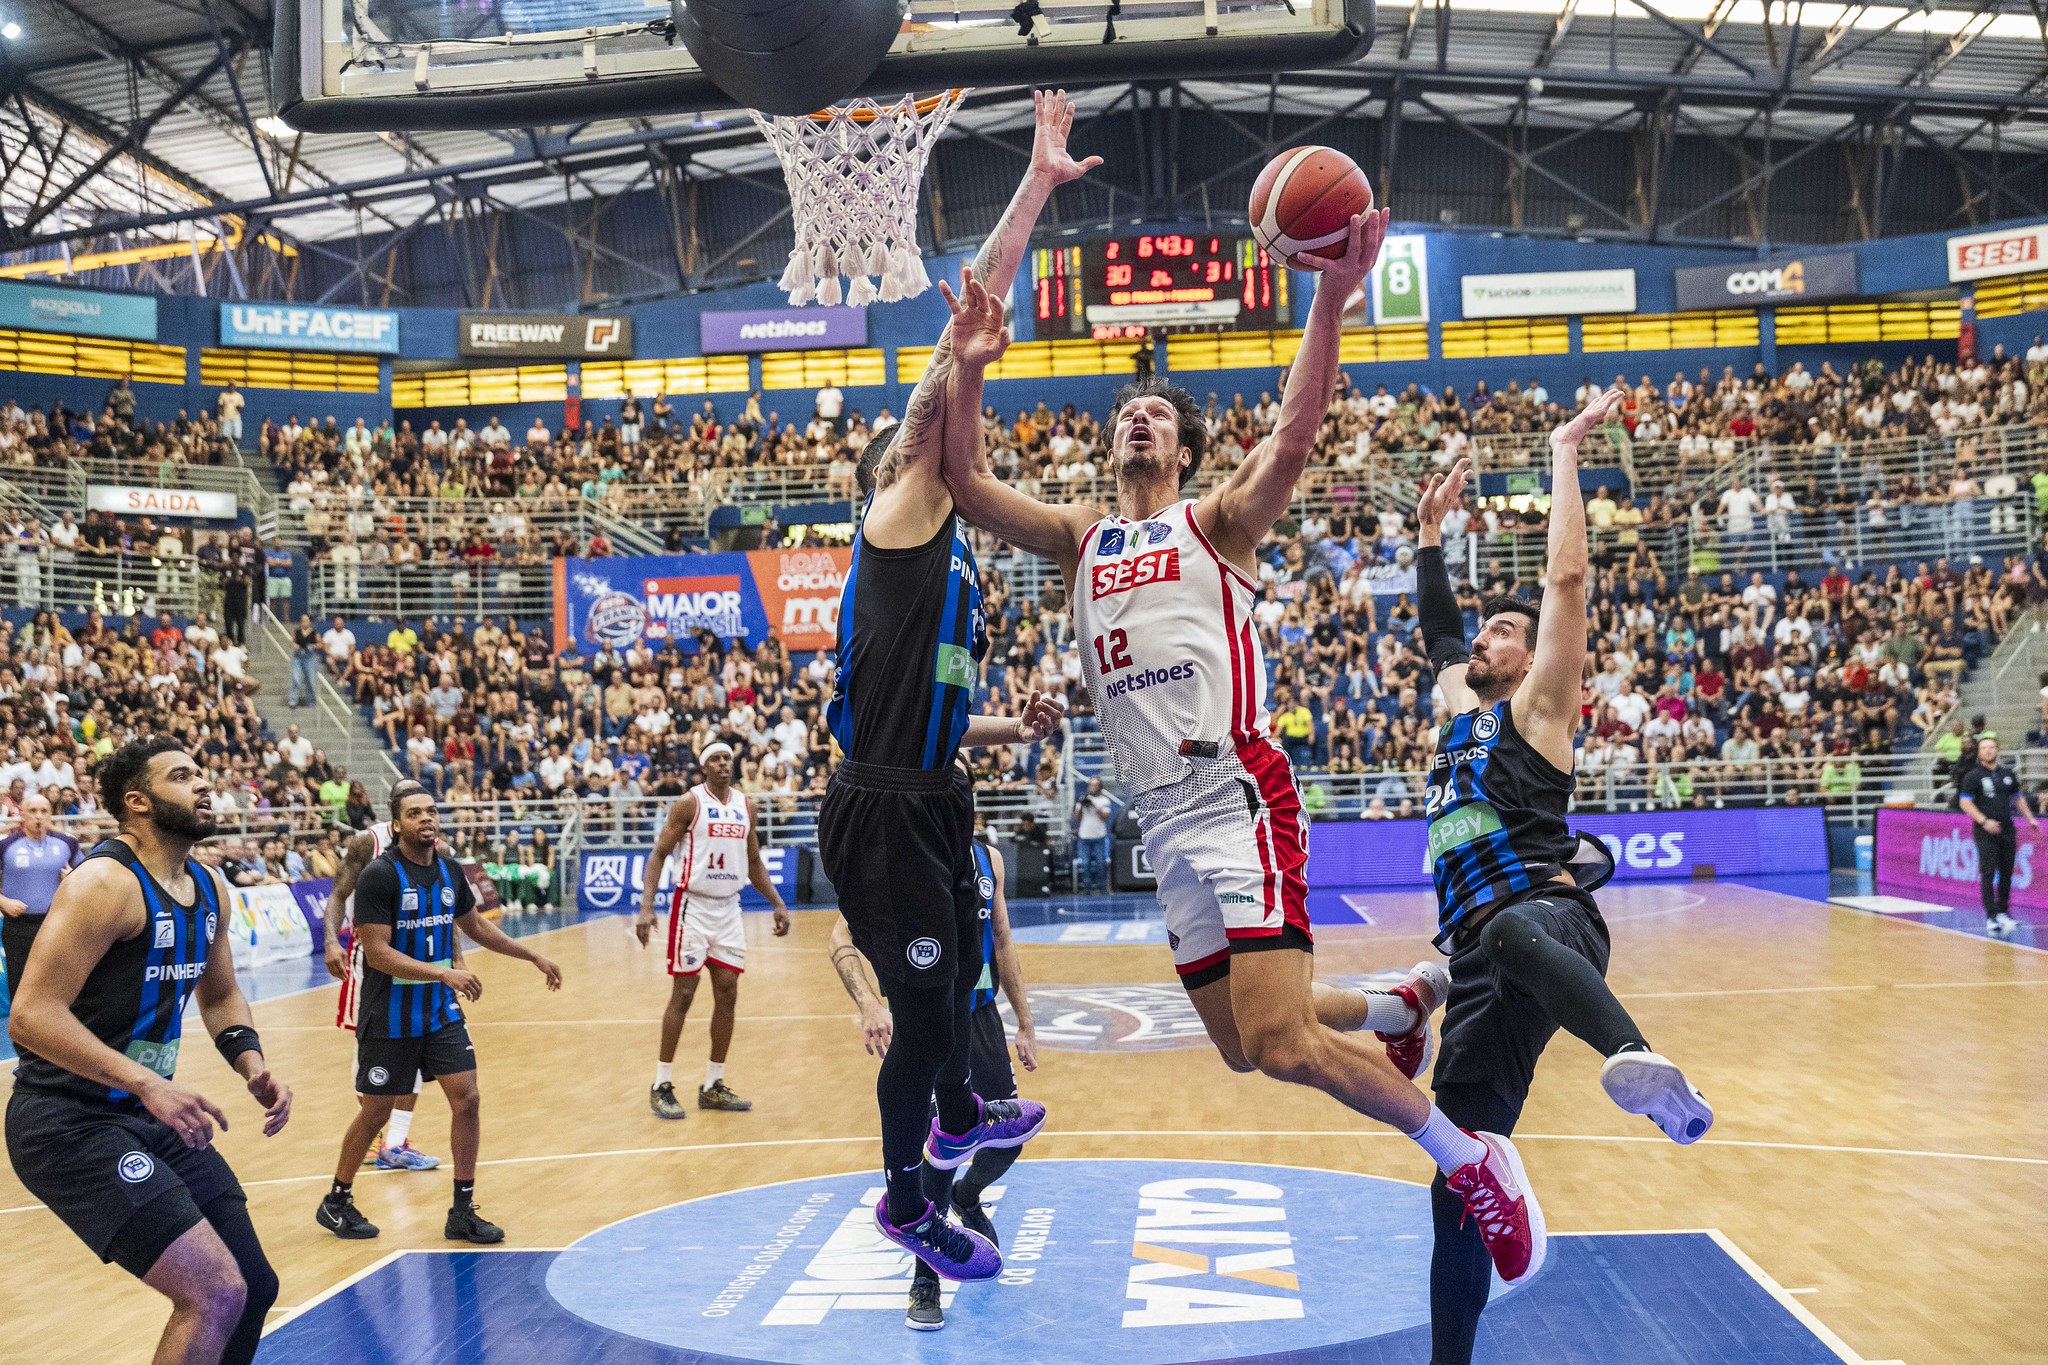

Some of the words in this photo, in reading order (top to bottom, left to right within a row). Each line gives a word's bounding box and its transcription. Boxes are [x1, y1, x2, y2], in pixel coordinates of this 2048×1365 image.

[1963, 239, 2031, 269] SESI
[1388, 260, 1411, 296] 8
[232, 306, 392, 340] Uni-FACEF
[470, 322, 565, 344] FREEWAY
[1095, 553, 1169, 595] SESI
[648, 591, 742, 619] MAIOR
[1094, 628, 1133, 675] 12
[1106, 662, 1194, 699] netshoes
[1425, 778, 1457, 816] 26
[711, 823, 745, 839] SESI
[707, 852, 724, 870] 14
[426, 935, 434, 957] 1
[1007, 1207, 1057, 1261] GOVERNO
[1121, 1178, 1305, 1328] CAIXA
[701, 1264, 772, 1317] BRASILEIRO
[997, 1268, 1037, 1286] DO
